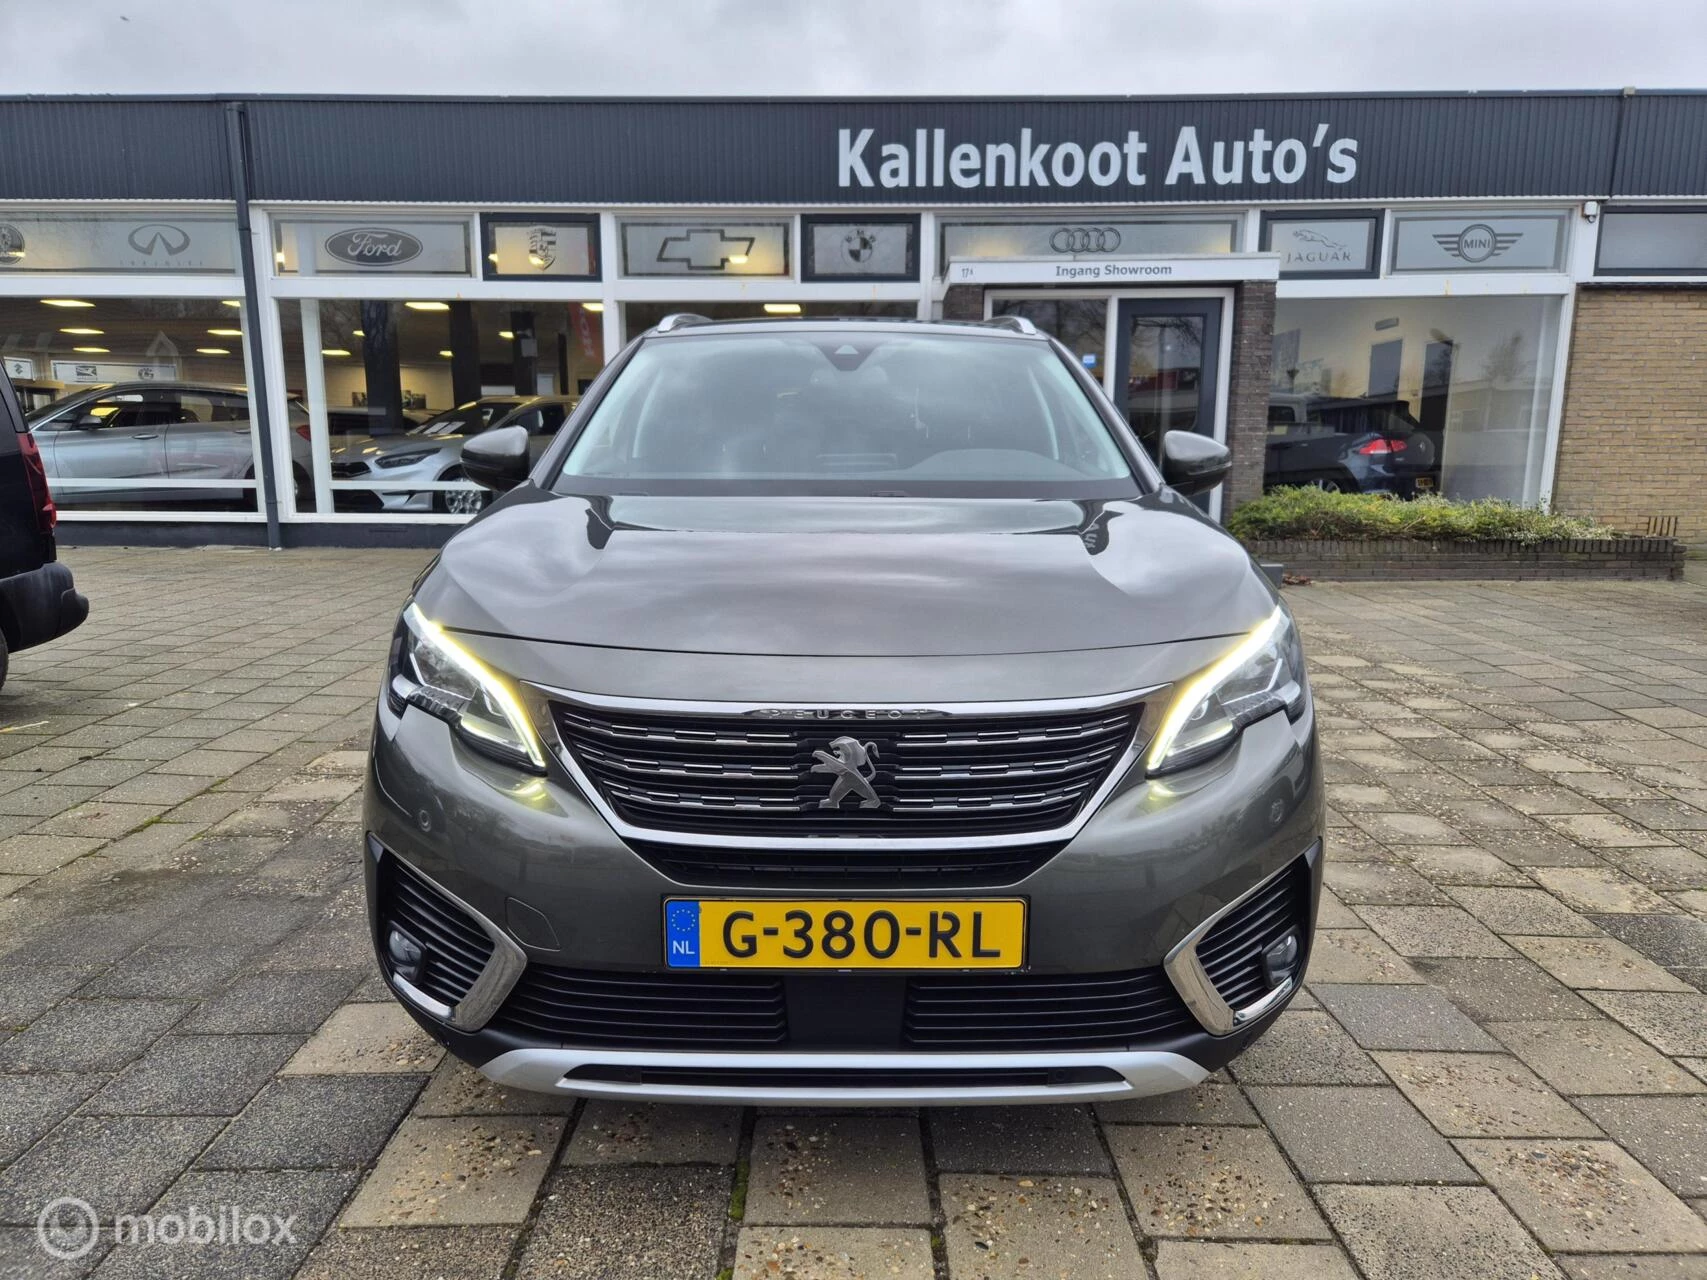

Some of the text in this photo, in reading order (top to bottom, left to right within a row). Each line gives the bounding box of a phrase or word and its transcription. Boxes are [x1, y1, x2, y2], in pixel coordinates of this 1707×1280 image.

[837, 123, 1358, 188] Kallenkoot Auto's
[347, 232, 403, 256] Ford
[1463, 238, 1491, 249] MINI
[1286, 251, 1352, 264] JAGUAR
[1056, 264, 1172, 279] Ingang Showroom
[722, 910, 1001, 959] G-380-RL
[672, 940, 695, 955] NL
